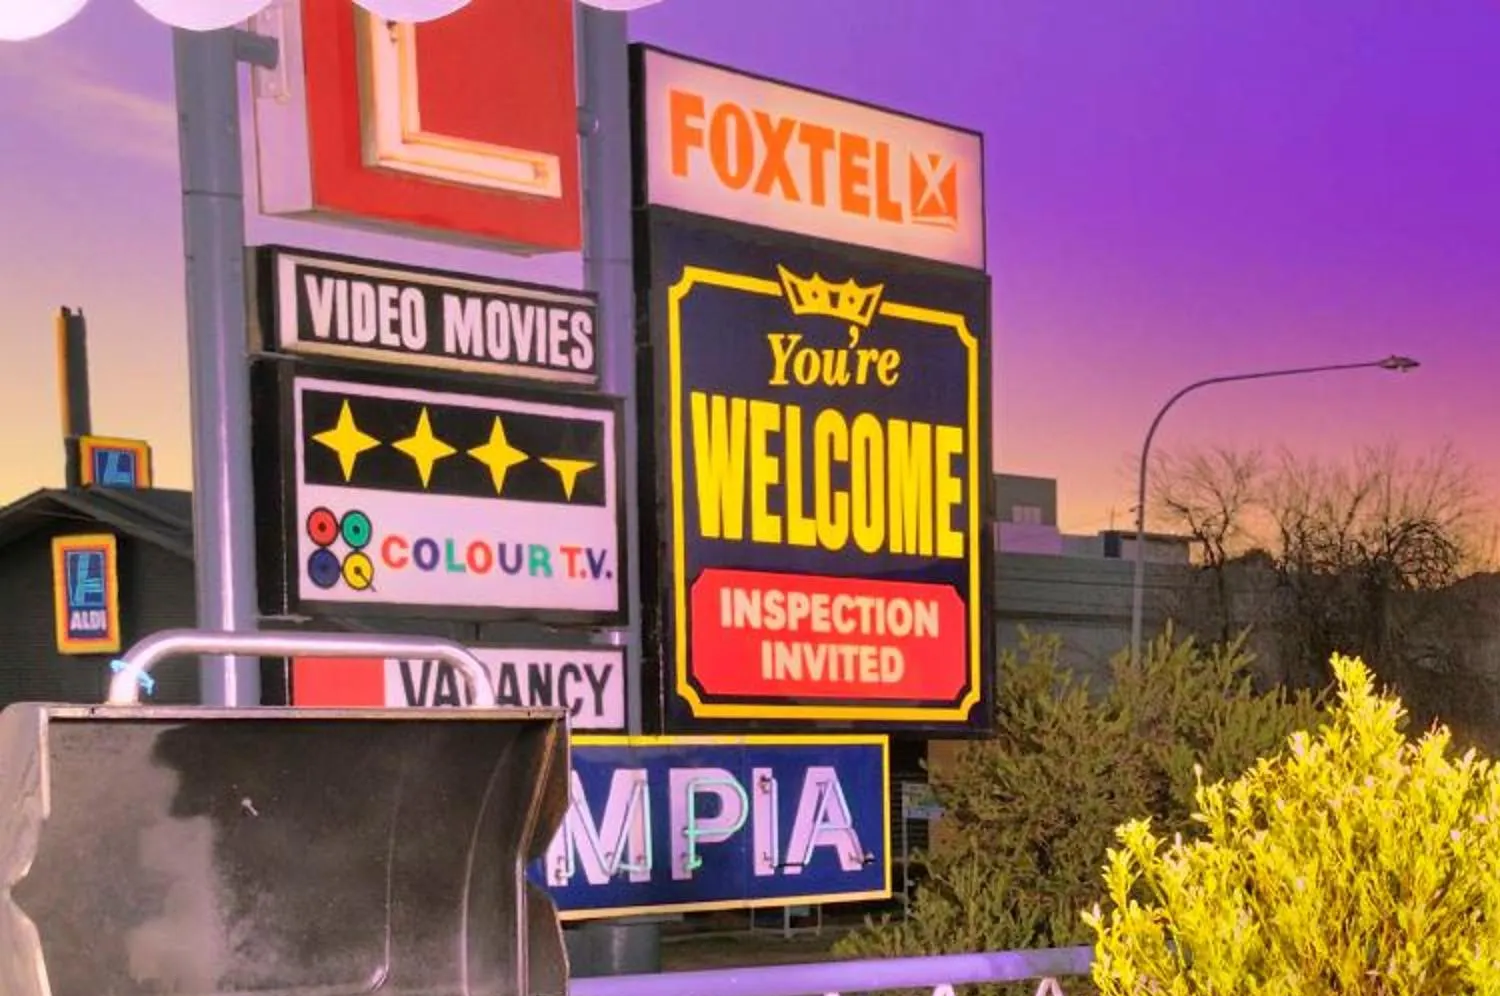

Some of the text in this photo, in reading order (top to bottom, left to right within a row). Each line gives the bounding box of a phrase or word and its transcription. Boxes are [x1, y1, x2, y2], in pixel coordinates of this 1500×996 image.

[668, 90, 904, 225] FOXTEL
[303, 273, 594, 372] VIDEO MOVIES
[767, 325, 900, 389] You're
[690, 392, 965, 560] WELCOME
[380, 535, 613, 580] COLOUR T.V.
[70, 610, 107, 631] ALDI
[719, 587, 940, 638] INSPECTION
[398, 657, 615, 718] VAANCY
[761, 642, 906, 684] INVITED
